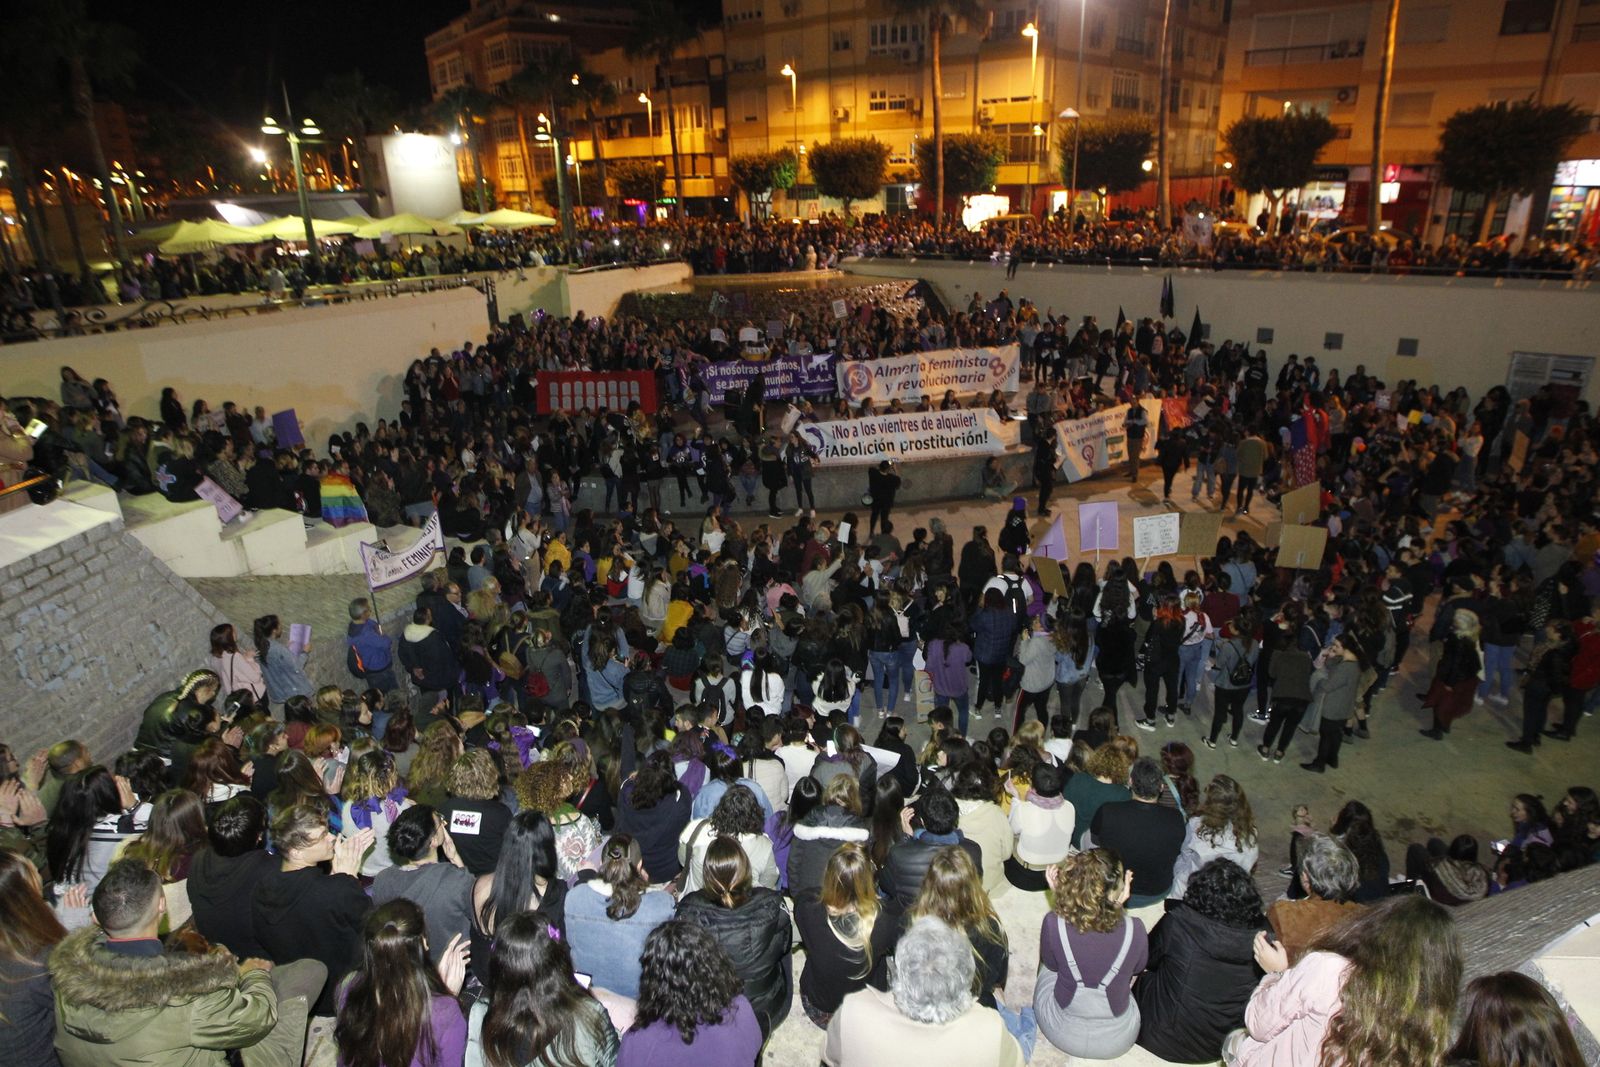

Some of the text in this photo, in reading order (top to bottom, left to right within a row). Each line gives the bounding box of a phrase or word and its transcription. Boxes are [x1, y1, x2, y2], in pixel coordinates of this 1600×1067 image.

[720, 364, 760, 376] nosotras
[928, 356, 989, 373] feminista
[988, 356, 1006, 378] 8
[716, 380, 726, 390] se
[729, 379, 749, 390] para
[885, 381, 893, 396] y
[897, 373, 986, 392] revolucionaria
[832, 412, 977, 440] ¡No a los vientres de alquiler!
[825, 439, 895, 458] ¡Abolición
[900, 430, 988, 454] prostitución!
